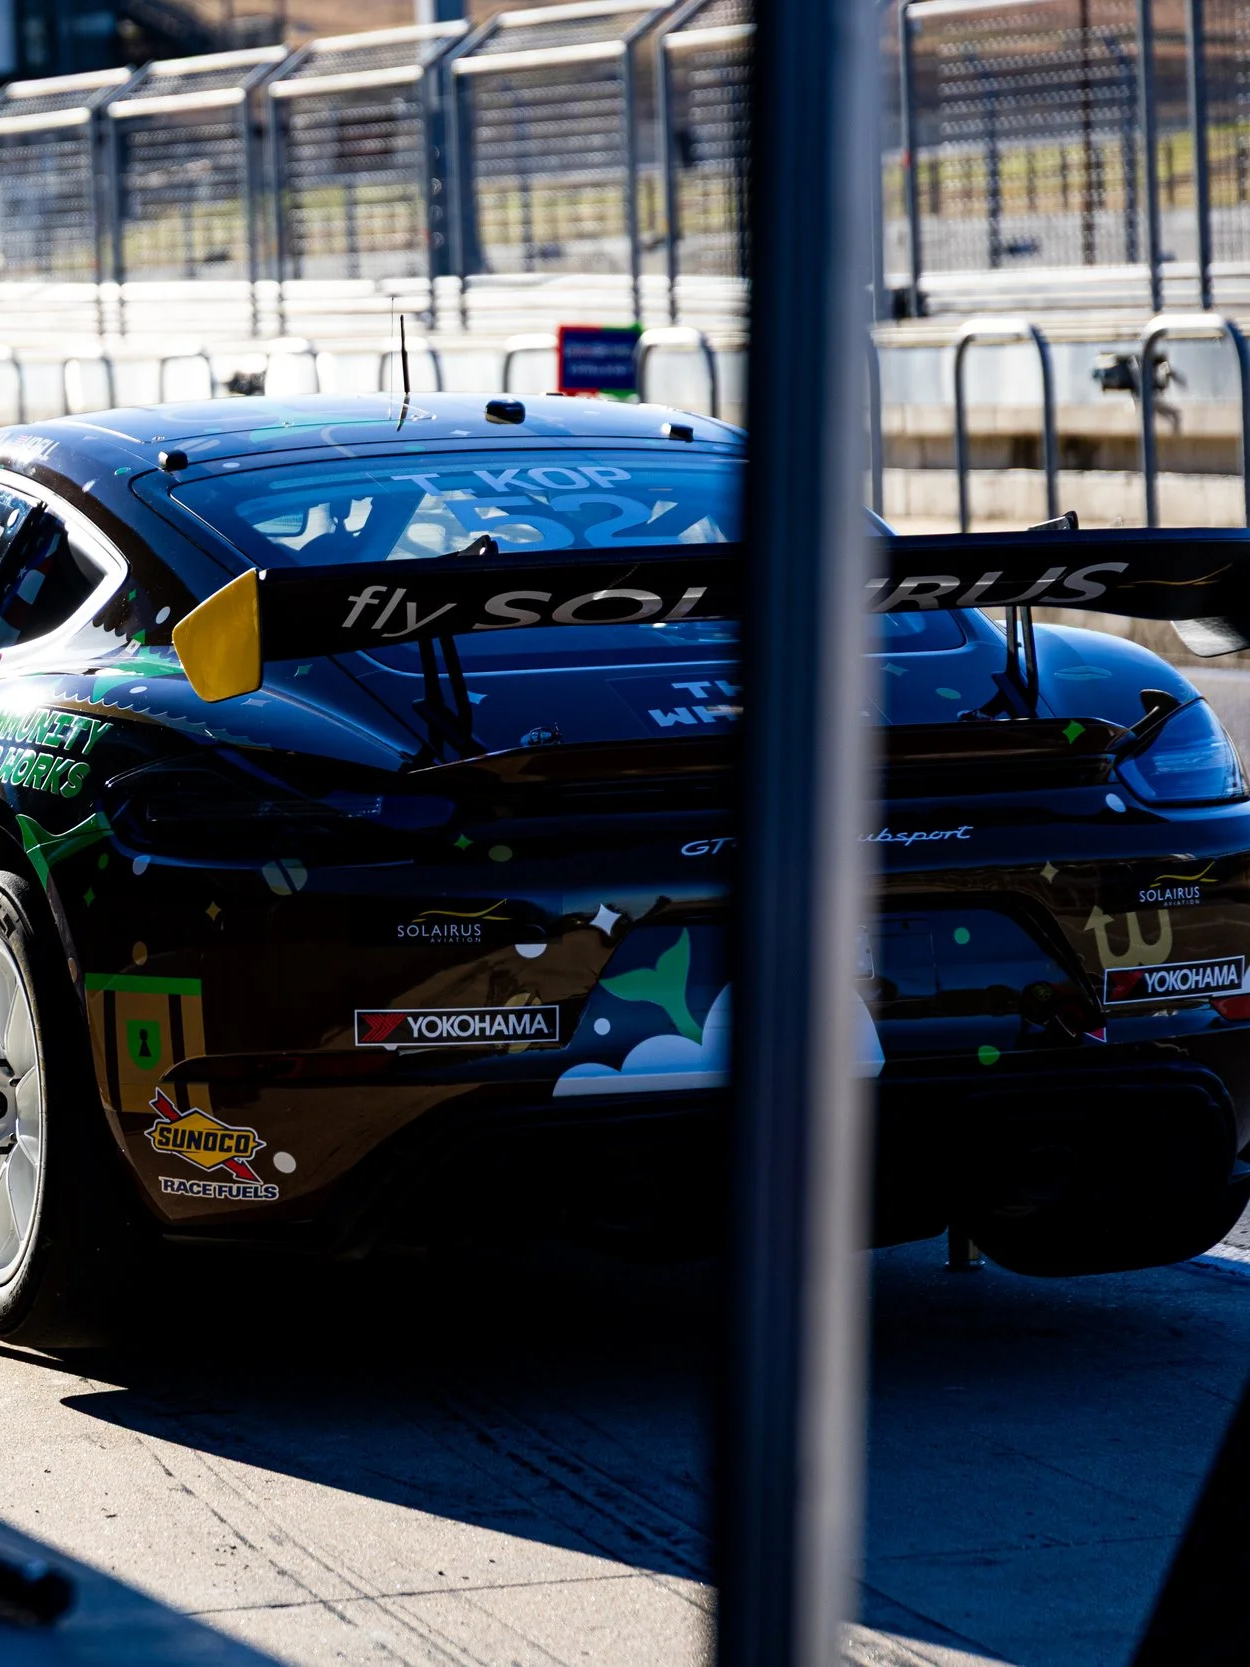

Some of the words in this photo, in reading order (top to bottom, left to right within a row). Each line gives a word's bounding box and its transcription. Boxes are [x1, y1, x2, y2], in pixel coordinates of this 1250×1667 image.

[392, 474, 476, 496] T.
[473, 467, 631, 492] KOP
[442, 494, 685, 554] 52
[342, 585, 457, 638] fly
[472, 562, 1129, 630] SOLIRUS
[1139, 886, 1200, 903] SOLAIRUS
[397, 923, 482, 937] SOLAIRUS
[1144, 963, 1239, 994] YOKOHAMA
[406, 1013, 549, 1039] YOKOHAMA
[157, 1126, 251, 1154] SUNOCO
[161, 1177, 214, 1197] RACE
[216, 1183, 279, 1200] FUELS
